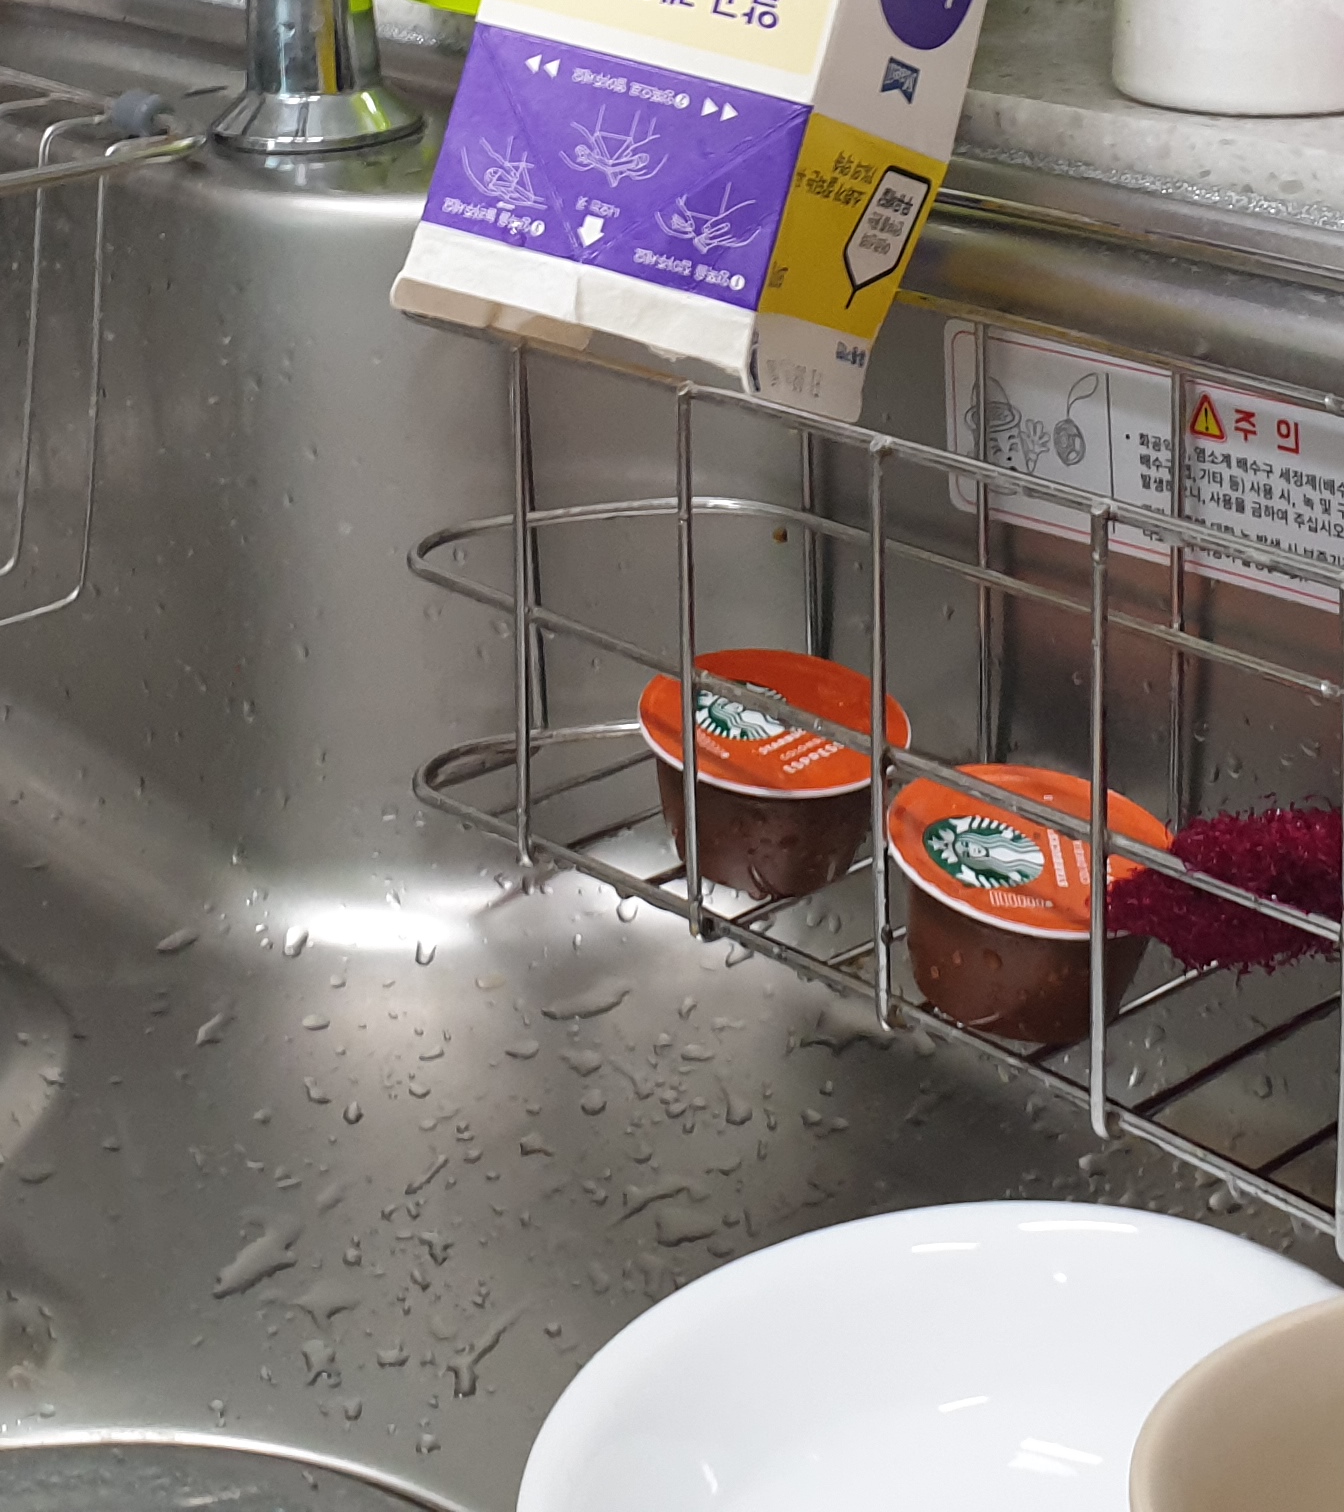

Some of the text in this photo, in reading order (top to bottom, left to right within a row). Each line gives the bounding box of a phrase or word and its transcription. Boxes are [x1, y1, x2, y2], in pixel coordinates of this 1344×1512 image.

[1194, 446, 1233, 470] 염소계
[1236, 456, 1274, 478] 배수구
[1199, 467, 1224, 486] 기타
[1229, 474, 1246, 495] 등)
[1248, 481, 1274, 500] 사용
[1209, 490, 1246, 514] 사용을
[1251, 500, 1289, 526] 금하여
